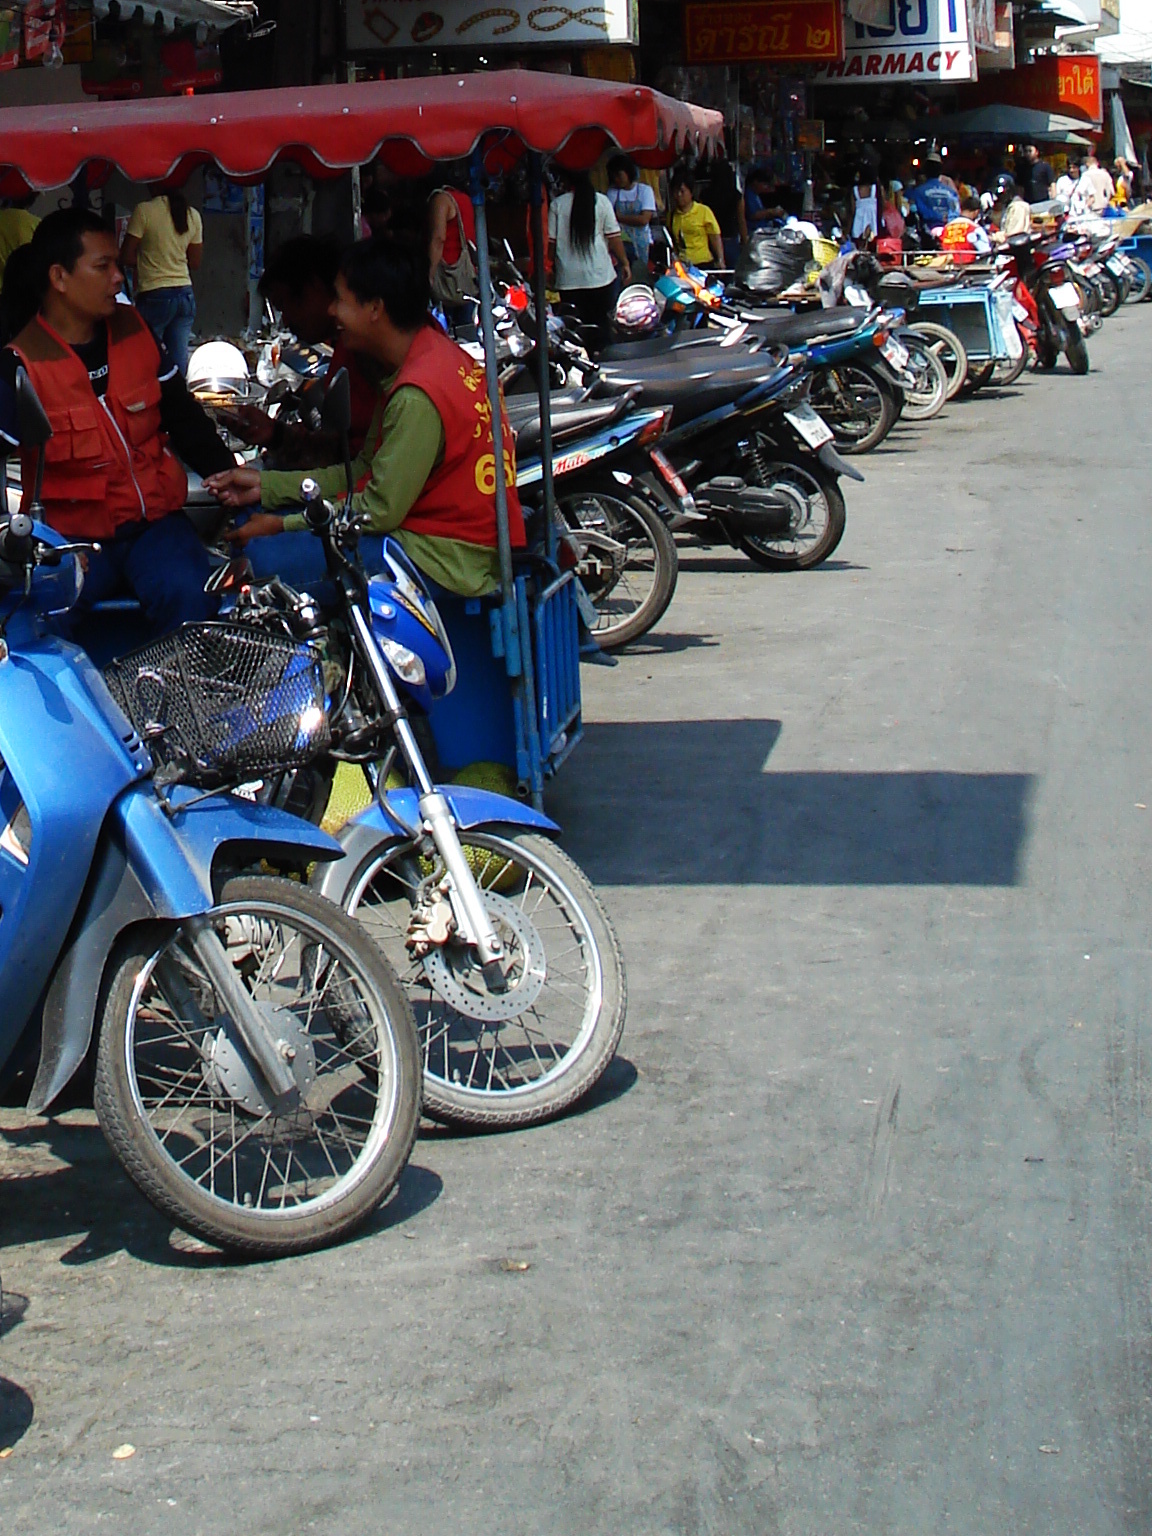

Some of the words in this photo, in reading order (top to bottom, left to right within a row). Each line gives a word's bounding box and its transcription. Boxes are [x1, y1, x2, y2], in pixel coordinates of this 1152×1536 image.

[695, 12, 791, 55] ดารณี
[805, 23, 831, 50] ๒
[817, 48, 962, 78] PHARMACY
